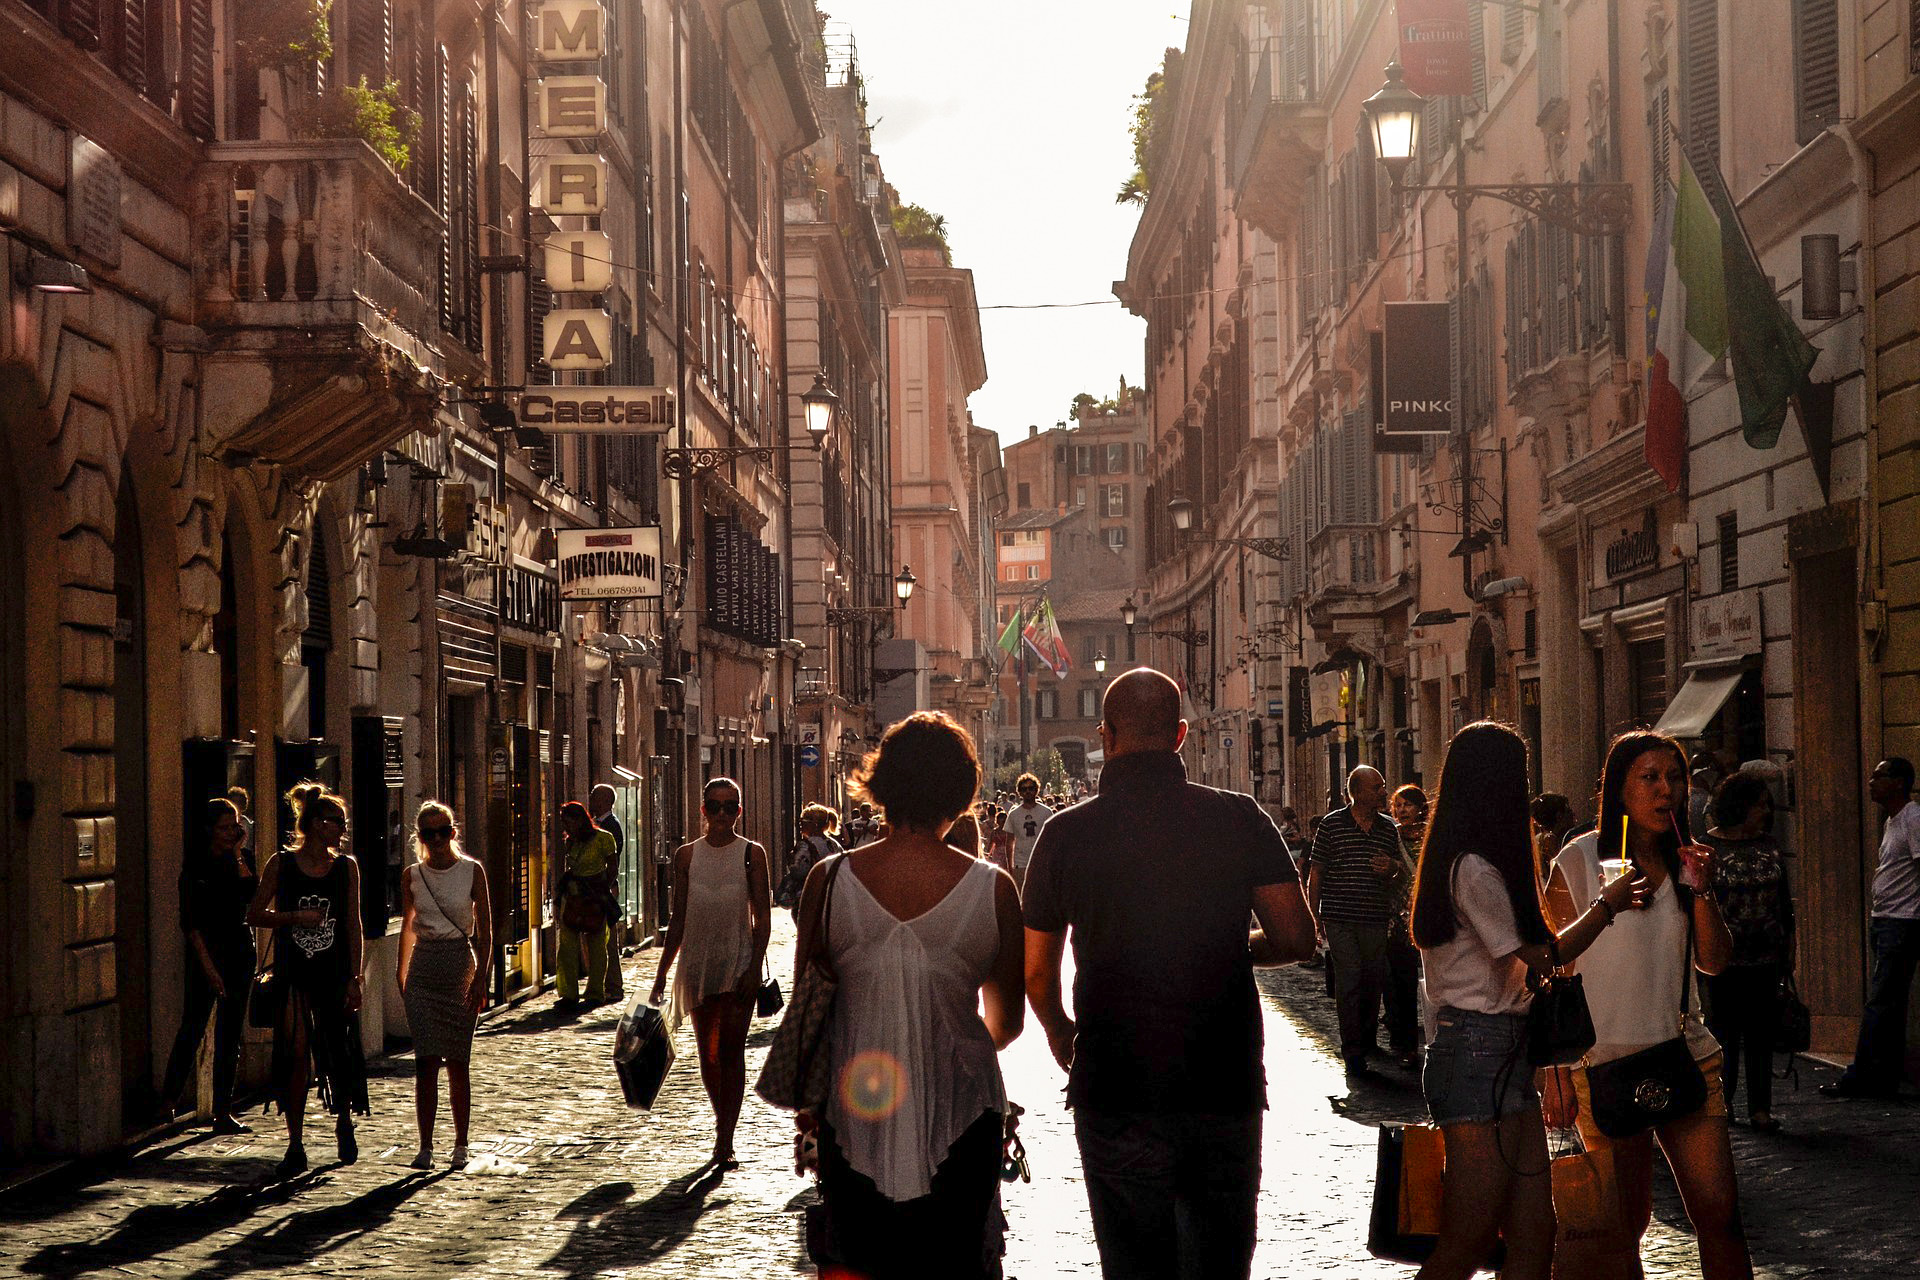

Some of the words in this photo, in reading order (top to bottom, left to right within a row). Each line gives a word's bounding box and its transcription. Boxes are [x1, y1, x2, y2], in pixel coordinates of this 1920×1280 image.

[1407, 26, 1464, 43] frattina
[1425, 66, 1451, 76] house
[520, 394, 675, 425] Castelli
[561, 550, 656, 585] INVESTIGAZIONI
[715, 522, 728, 584] CASTELLANI
[730, 530, 740, 591] CASTELLANI
[575, 587, 595, 596] TEL.
[597, 586, 646, 595] 066789341
[769, 559, 777, 609] CASTELLANI
[717, 588, 728, 623] FLAVIO
[731, 594, 740, 627] FLAVIO
[770, 613, 778, 643] FLAVIO
